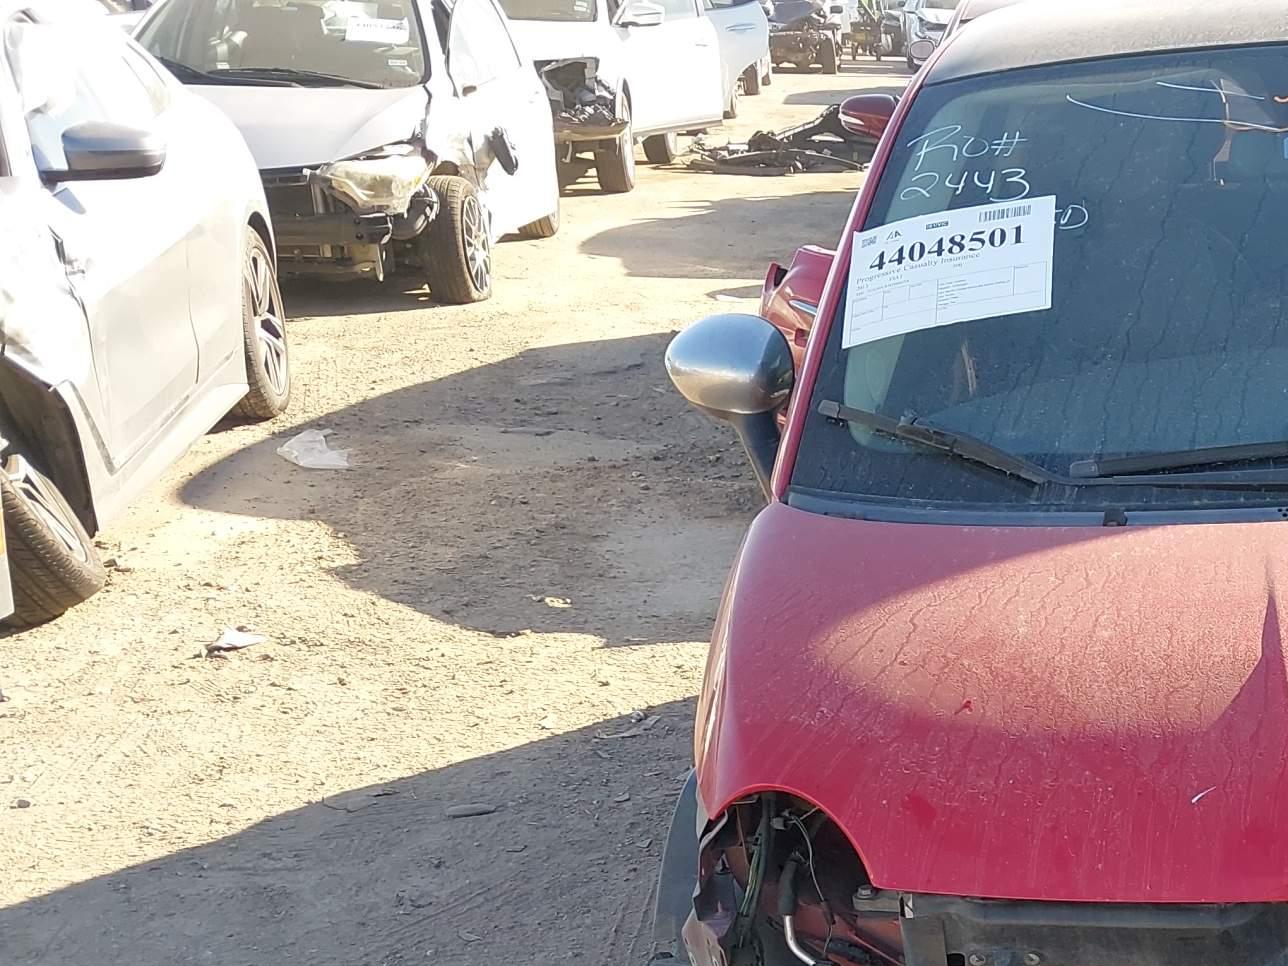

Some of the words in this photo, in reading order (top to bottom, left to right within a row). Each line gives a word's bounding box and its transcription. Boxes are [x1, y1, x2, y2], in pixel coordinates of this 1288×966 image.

[900, 168, 1030, 202] 2443
[869, 223, 1024, 272] 44048501
[856, 266, 902, 285] Progressive
[903, 257, 938, 272] Casualty
[940, 251, 981, 265] Insurance
